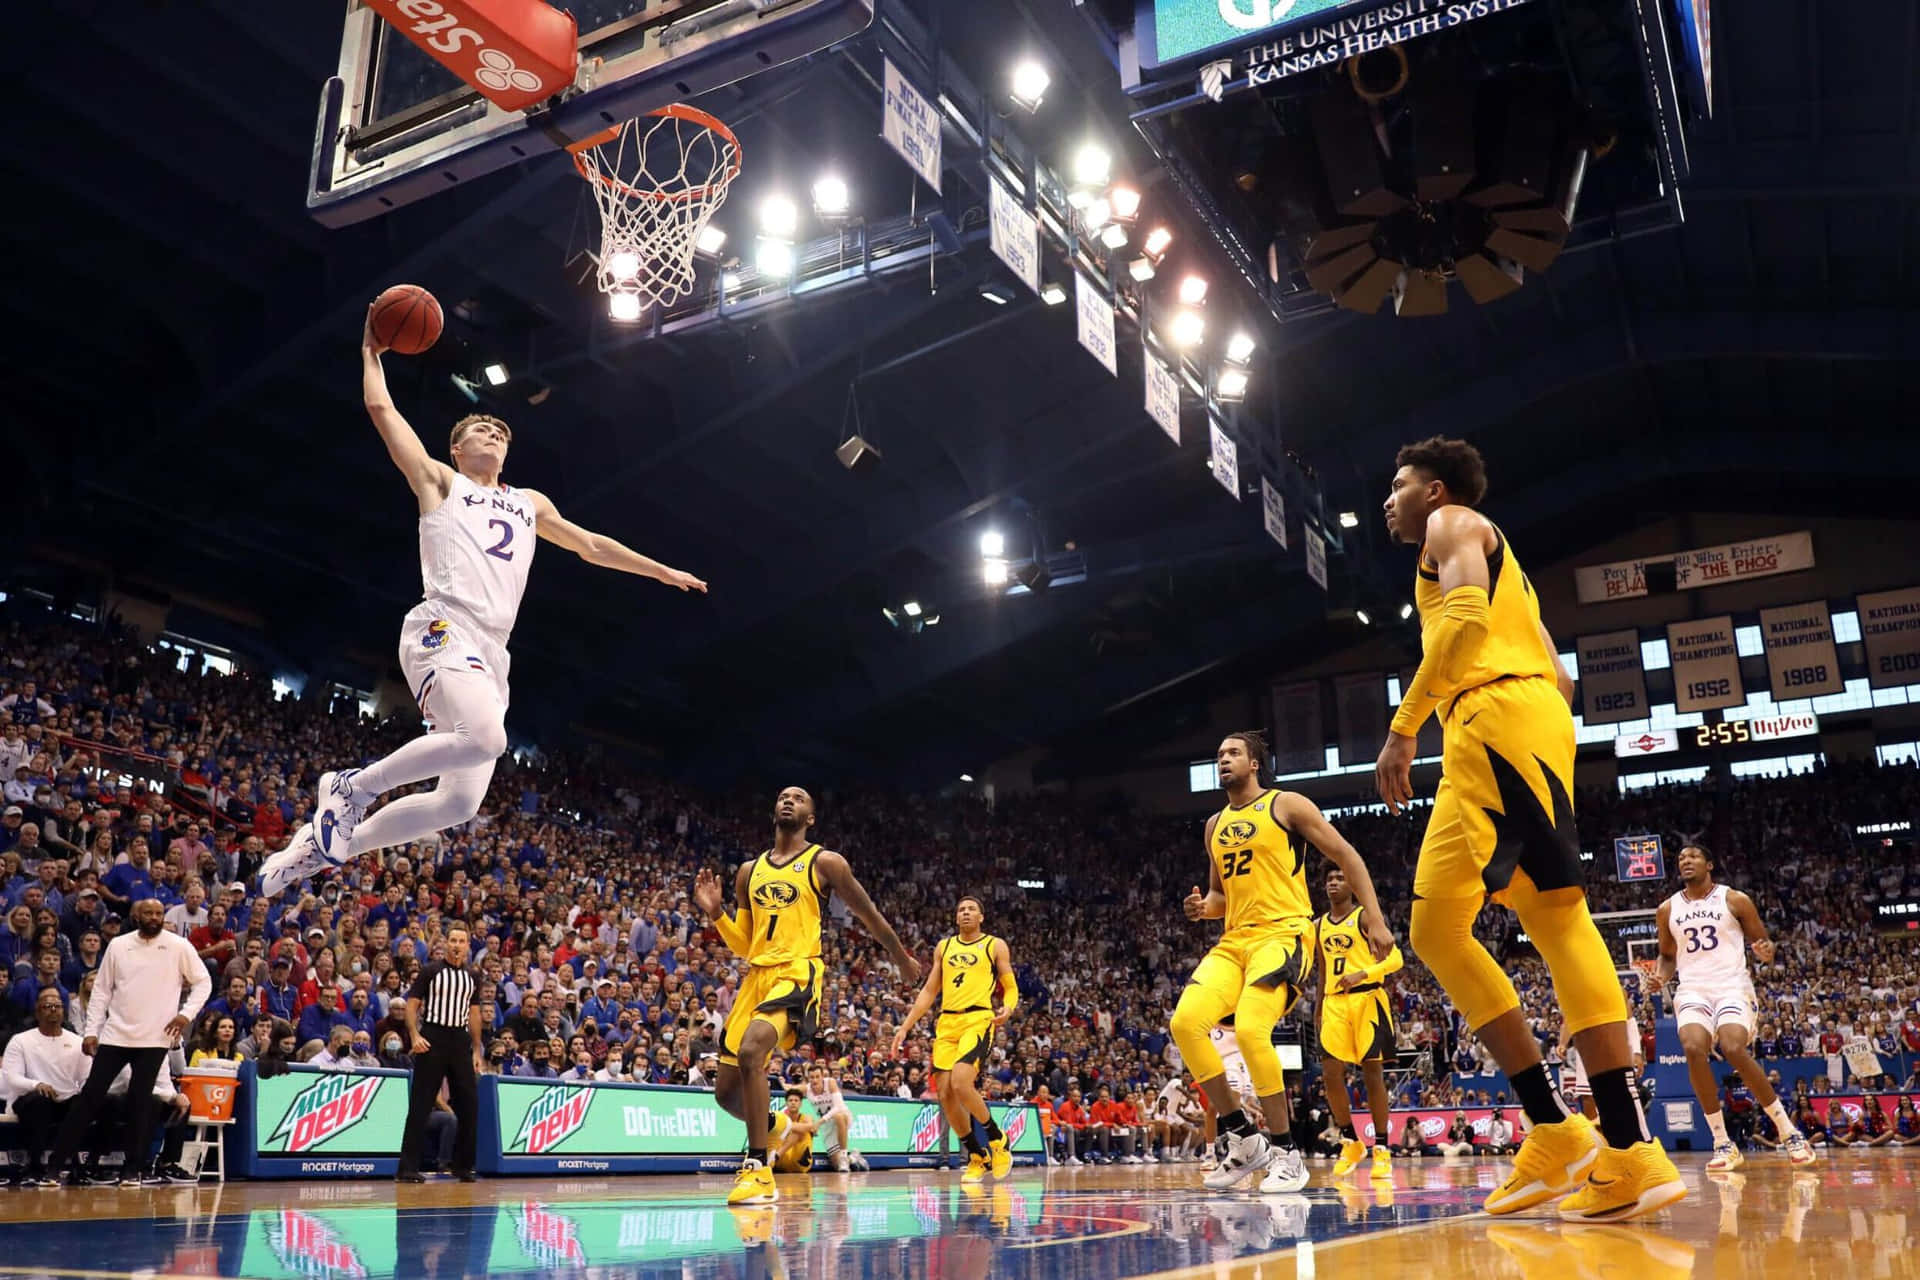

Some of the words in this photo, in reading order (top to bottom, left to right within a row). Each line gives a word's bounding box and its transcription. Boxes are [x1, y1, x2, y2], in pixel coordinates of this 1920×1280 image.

[388, 0, 484, 53] Sta
[1244, 37, 1294, 67] THE
[1299, 0, 1446, 48] UNIVERSIT
[1245, 44, 1339, 88] KANSAS
[1340, 13, 1442, 58] HEALTH
[1447, 0, 1527, 26] SYST
[463, 493, 533, 528] KNSAS
[485, 518, 515, 562] 2
[1606, 576, 1646, 597] BEWA
[1770, 616, 1823, 633] NATIONAL
[1677, 631, 1727, 647] NATIONAL
[1766, 631, 1831, 649] CHAMPIONS
[1586, 645, 1633, 660] NATIONAL
[1673, 645, 1734, 662] CHAMPIONS
[1880, 652, 1920, 673] 200
[1582, 658, 1641, 674] CHAMPIONS
[1783, 665, 1827, 687] 1988
[1687, 678, 1731, 700] 1952
[1595, 692, 1636, 712] 1923
[1697, 721, 1749, 746] 2:55
[1856, 821, 1911, 834] NISSAN
[1222, 849, 1254, 880] 32
[1675, 910, 1723, 926] KANSAS
[1879, 903, 1920, 914] NISS
[766, 915, 778, 941] 1
[1683, 925, 1719, 953] 33
[1333, 957, 1346, 975] 0
[953, 972, 966, 988] 4
[212, 1087, 225, 1100] G
[623, 1106, 652, 1136] DO
[652, 1114, 677, 1136] THE
[676, 1108, 717, 1136] DEW
[856, 1114, 889, 1139] DEW
[302, 1162, 337, 1172] ROCKET
[338, 1162, 375, 1174] Mortgage
[558, 1160, 583, 1169] ROCKET
[583, 1161, 609, 1170] Mortgage
